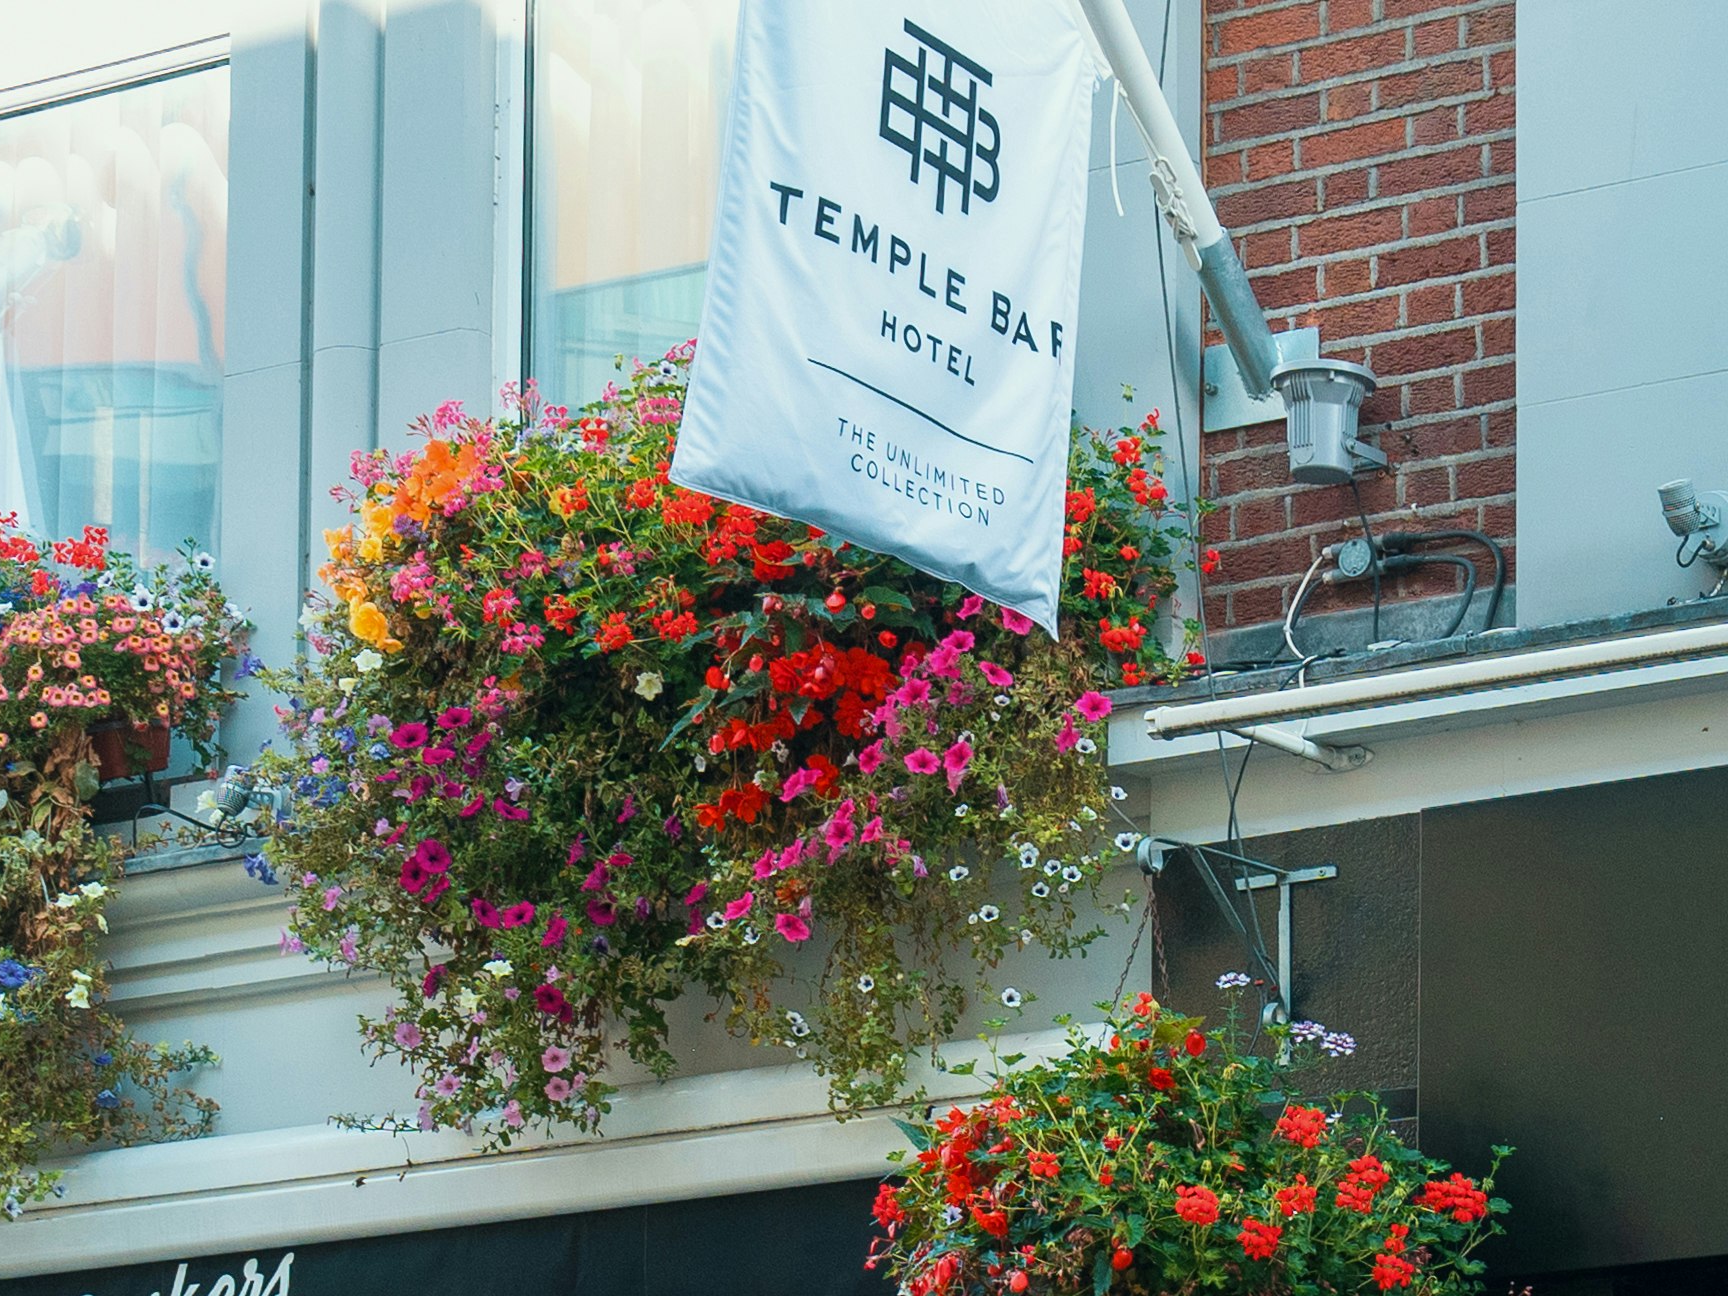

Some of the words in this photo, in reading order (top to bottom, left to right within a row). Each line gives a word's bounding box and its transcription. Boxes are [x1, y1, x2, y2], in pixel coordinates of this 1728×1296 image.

[770, 180, 967, 315] TEMPLE
[880, 310, 975, 387] HOTEL
[838, 417, 875, 452] THE
[887, 442, 1005, 505] UNLIMITED
[851, 454, 990, 527] COLLECTION
